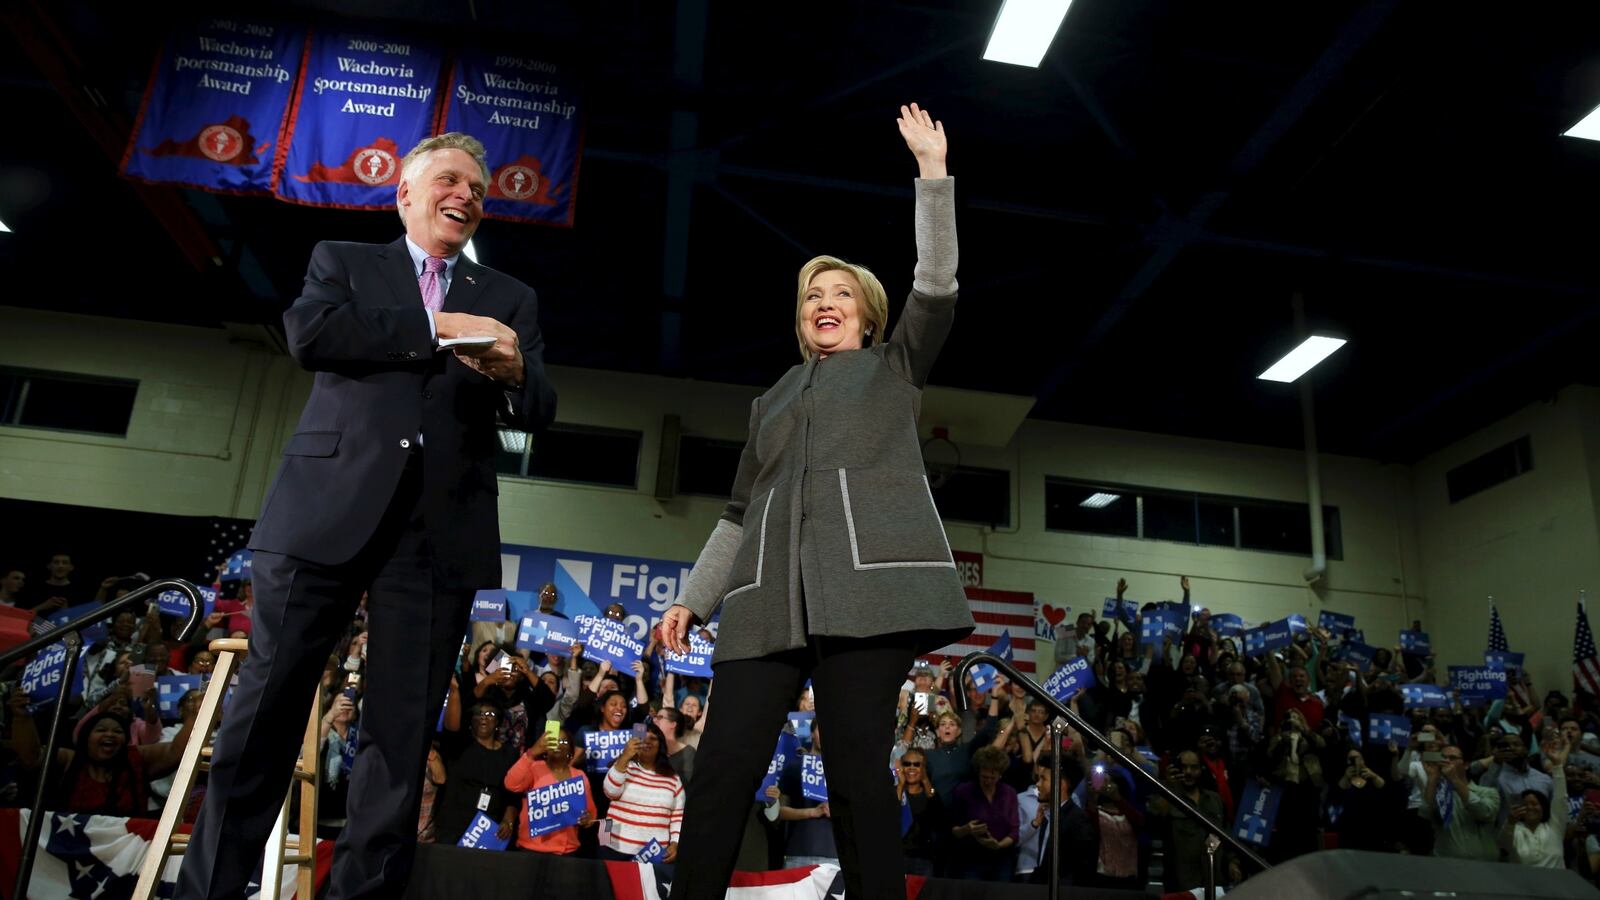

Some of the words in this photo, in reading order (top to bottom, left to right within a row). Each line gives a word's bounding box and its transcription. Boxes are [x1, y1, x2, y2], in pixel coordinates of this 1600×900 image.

[199, 36, 273, 60] Wachovia
[347, 39, 411, 56] 2000-2001
[175, 56, 290, 83] portsmanship
[337, 56, 414, 78] Wachovia
[198, 73, 251, 95] Award
[313, 77, 431, 103] Sportsmanship
[484, 72, 558, 96] Wachovia
[341, 98, 395, 117] Award
[456, 84, 576, 119] Sportsmanship
[488, 110, 539, 129] Award
[475, 600, 504, 612] Hillary
[547, 630, 577, 646] Hillary
[587, 634, 608, 651] for
[607, 644, 625, 658] us
[592, 622, 645, 656] Fighting
[688, 655, 705, 666] us
[41, 669, 61, 687] us
[1042, 658, 1089, 693] Fighting
[1061, 675, 1078, 689] us
[1457, 668, 1507, 683] Fighting
[1457, 680, 1475, 690] for
[1476, 681, 1492, 691] us
[585, 747, 608, 760] for
[801, 768, 823, 787] for
[527, 780, 585, 807] Fighting
[527, 805, 550, 823] for
[551, 801, 570, 815] us
